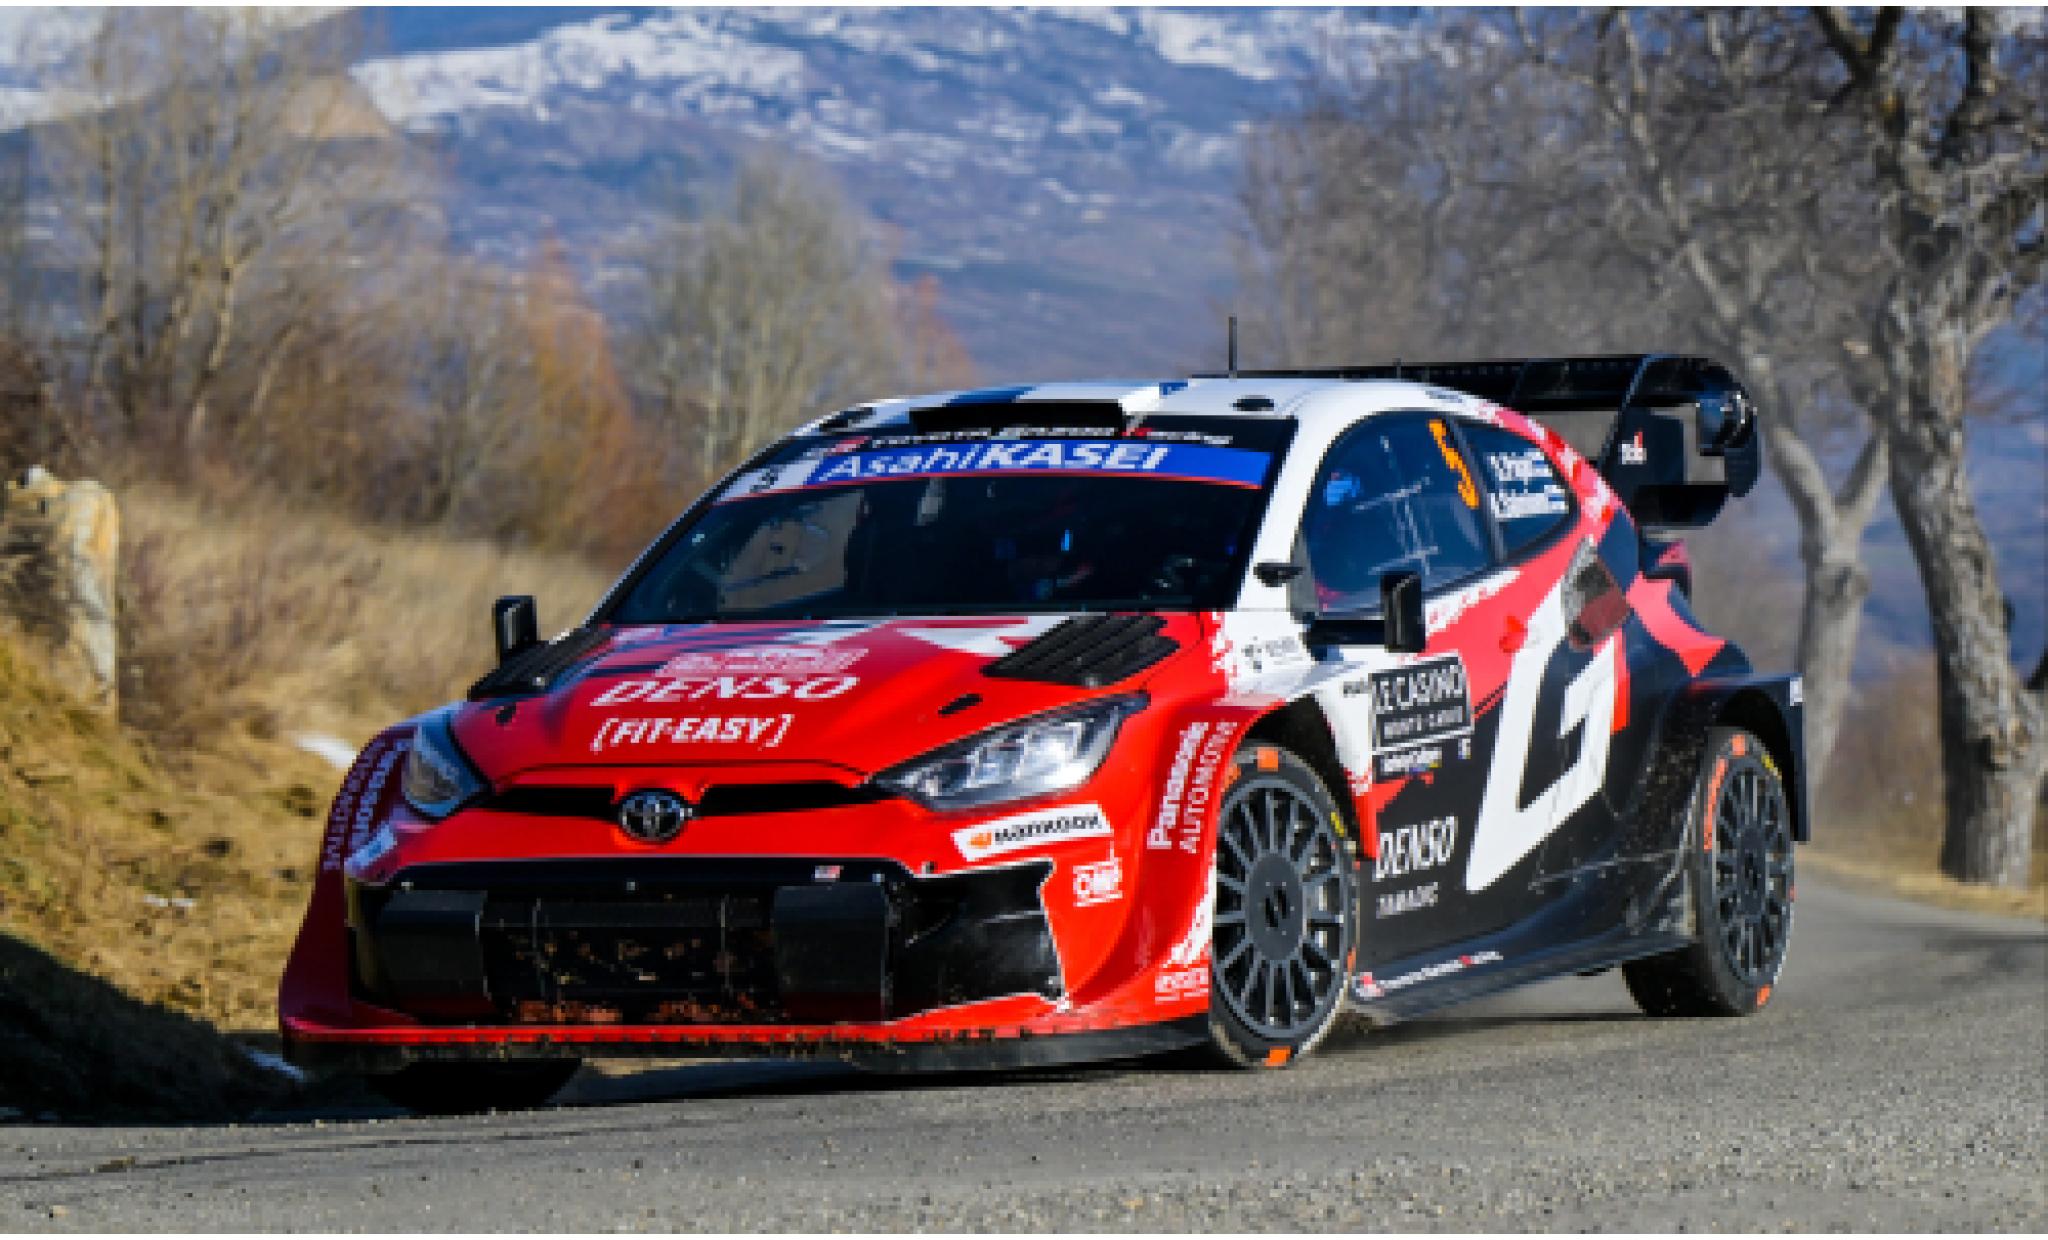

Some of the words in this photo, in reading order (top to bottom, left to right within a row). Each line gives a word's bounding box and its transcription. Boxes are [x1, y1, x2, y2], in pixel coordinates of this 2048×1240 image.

[589, 676, 861, 707] DENSO
[1147, 722, 1209, 850] Panasonic
[1374, 815, 1458, 882] DENSO
